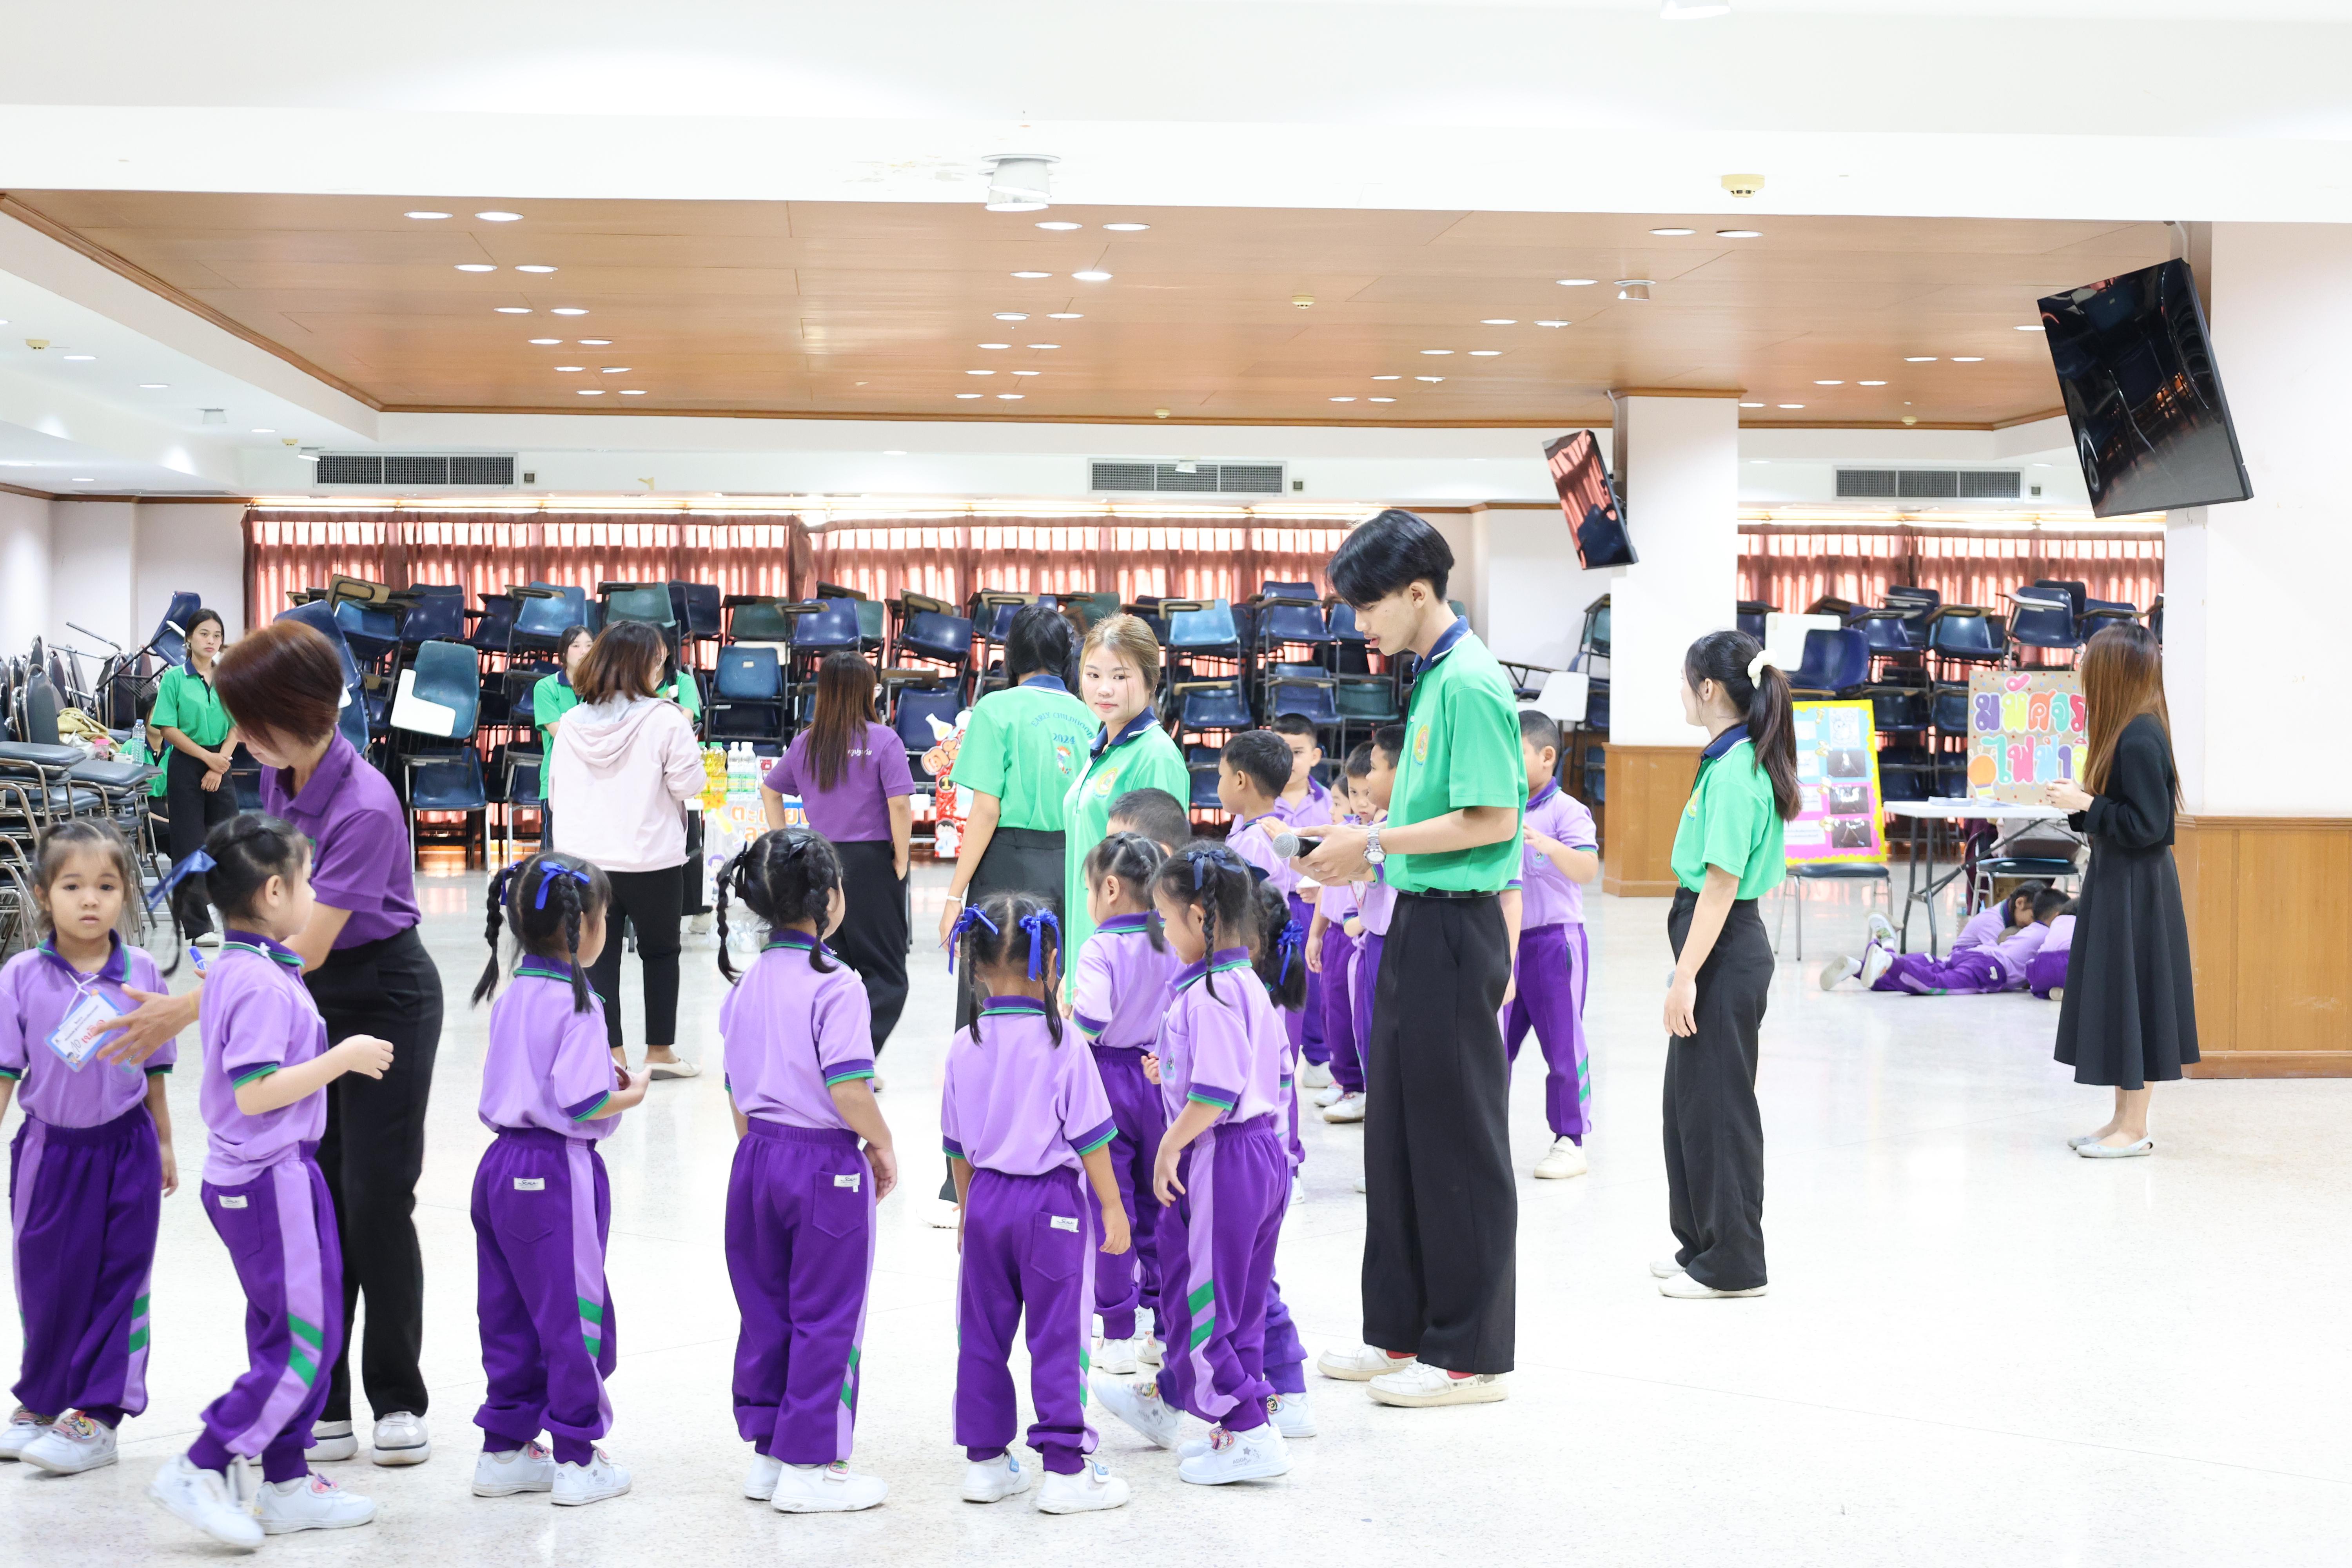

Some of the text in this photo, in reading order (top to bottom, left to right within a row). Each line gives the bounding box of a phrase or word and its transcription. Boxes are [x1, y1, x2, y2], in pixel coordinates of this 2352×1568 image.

[1974, 673, 2086, 733] มหัศจร
[1031, 712, 1093, 739] EARLY CHILDHOOD
[1053, 733, 1075, 744] 2024
[1980, 734, 2089, 784] ไฟฟ้าจิ
[941, 776, 951, 790] 1
